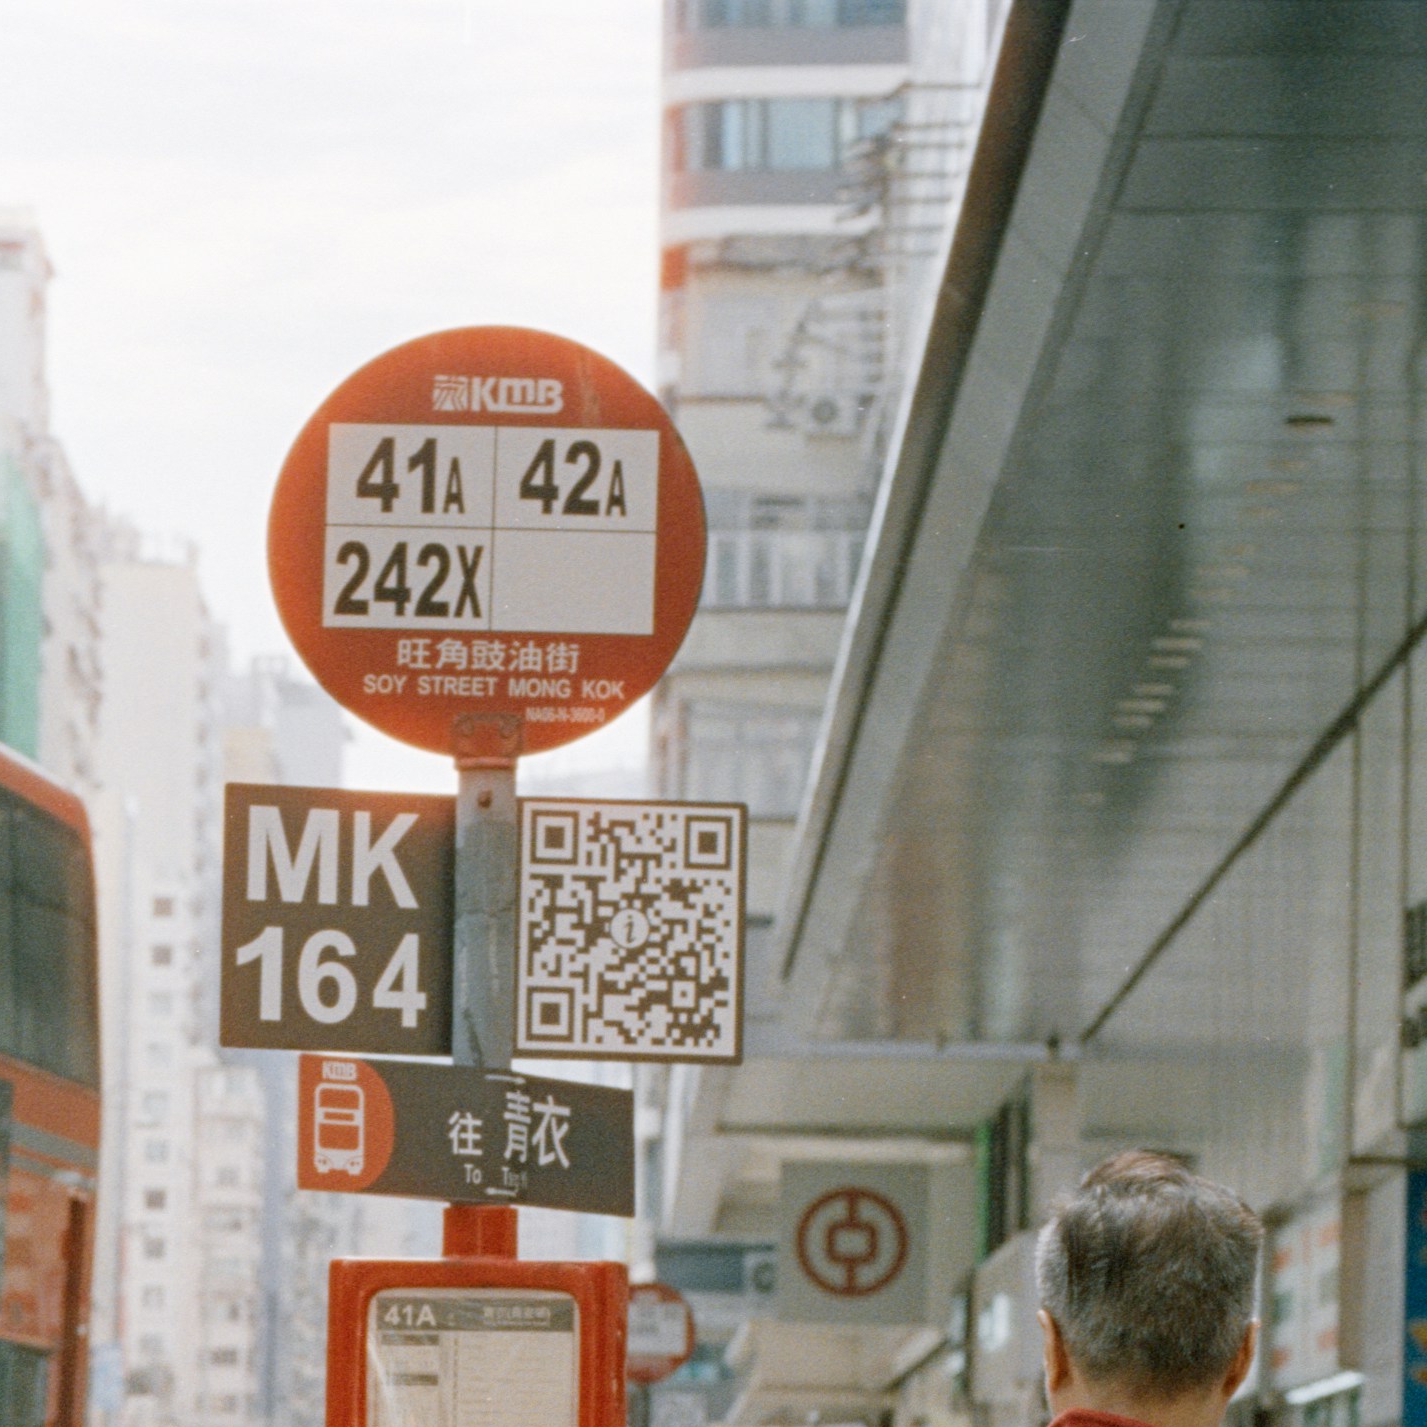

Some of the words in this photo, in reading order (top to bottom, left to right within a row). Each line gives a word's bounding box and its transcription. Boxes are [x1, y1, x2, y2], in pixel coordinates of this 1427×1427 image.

[469, 376, 564, 414] KMB
[355, 437, 465, 514] 41A
[519, 439, 626, 517] 42A
[333, 540, 483, 619] 242X
[397, 638, 580, 674] 旺角豉油街
[362, 673, 406, 695] SOY
[417, 675, 497, 698] STREET
[508, 677, 572, 700] MONG
[582, 679, 626, 701] KOK
[247, 804, 420, 910] MK
[236, 926, 427, 1029] 164
[448, 1111, 483, 1156] 往
[502, 1090, 571, 1169] 青衣
[464, 1163, 482, 1185] To
[383, 1303, 437, 1327] 41A
